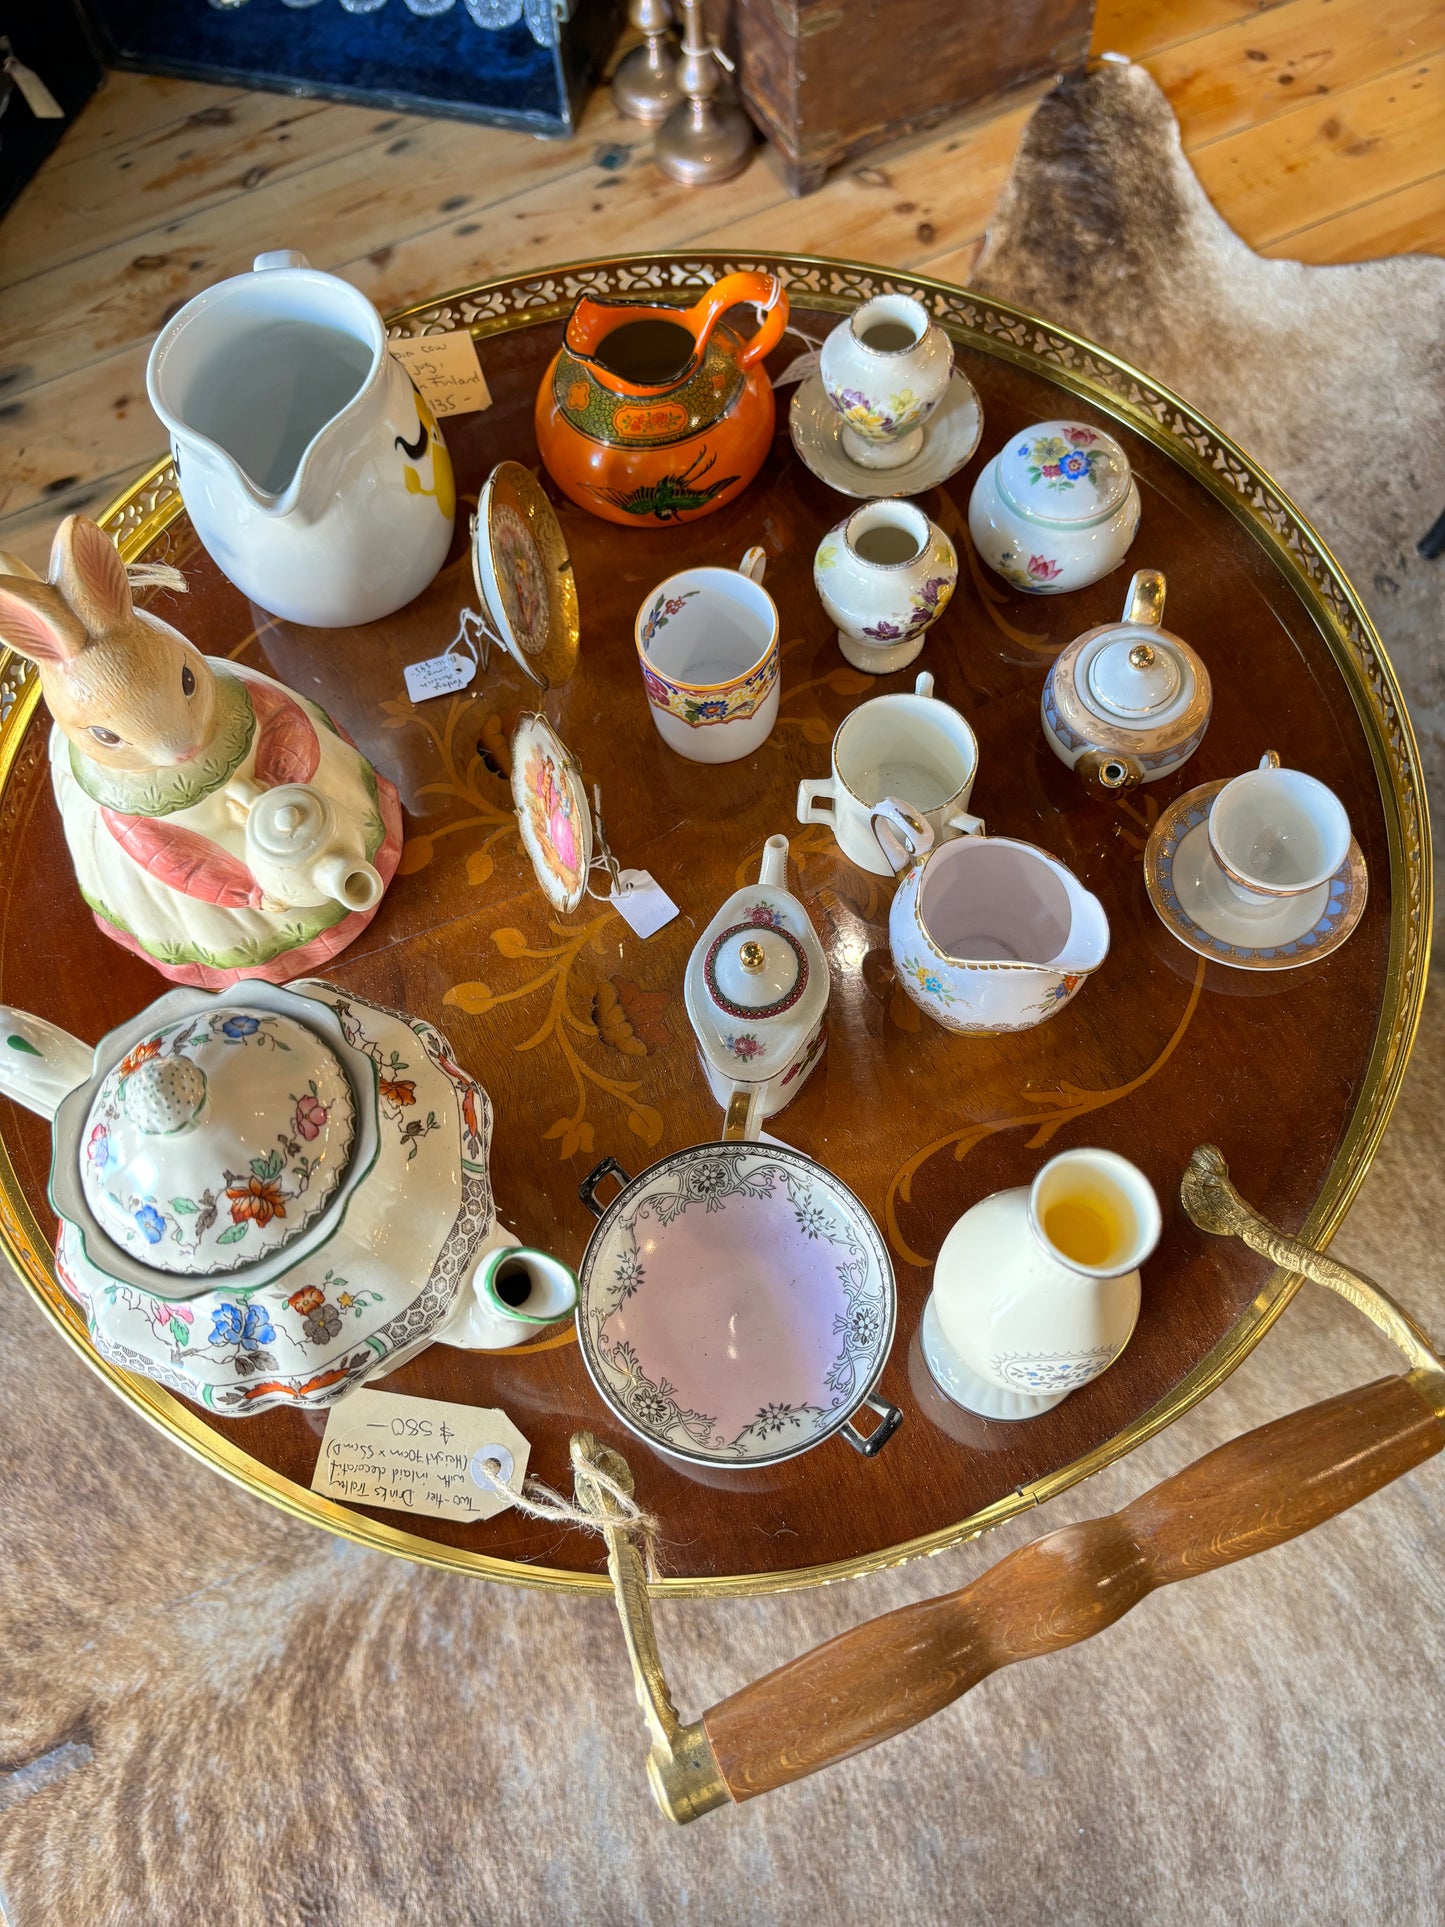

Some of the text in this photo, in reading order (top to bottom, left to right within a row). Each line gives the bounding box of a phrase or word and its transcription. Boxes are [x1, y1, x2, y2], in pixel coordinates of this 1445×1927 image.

[421, 343, 447, 353] cow
[426, 371, 481, 388] Finland
[425, 1451, 468, 1470] (Height
[392, 1468, 428, 1486] inlaid
[436, 1473, 465, 1488] with
[328, 1479, 481, 1512] Two-tier Drinks Trolley
